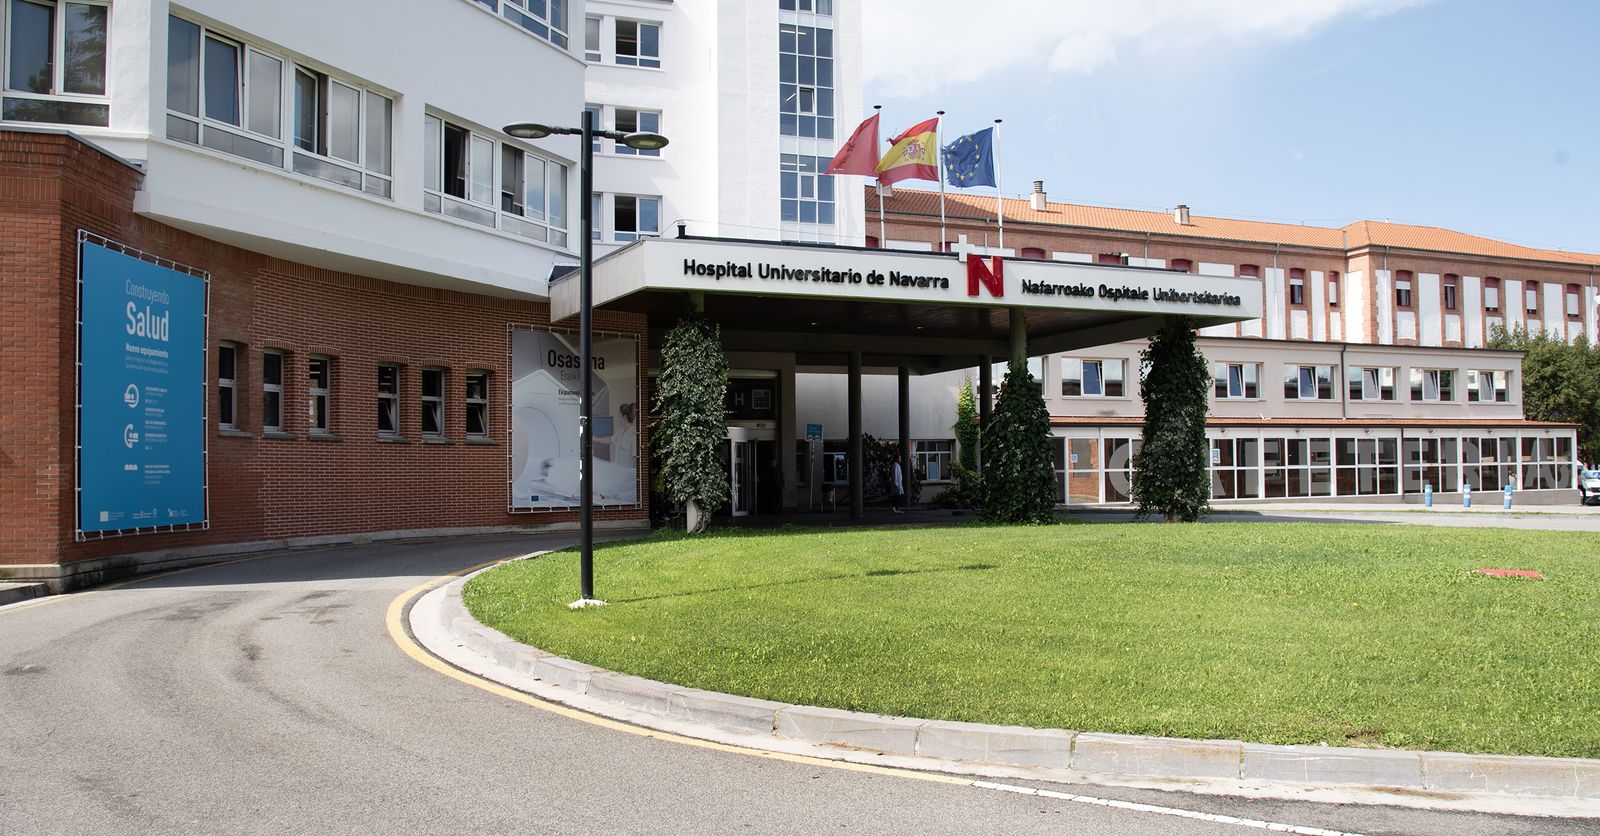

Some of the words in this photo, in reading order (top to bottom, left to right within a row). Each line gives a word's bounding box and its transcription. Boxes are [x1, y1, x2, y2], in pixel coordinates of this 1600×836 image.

[683, 258, 752, 280] Hospital
[758, 263, 862, 284] Universitario
[866, 270, 885, 285] de
[889, 271, 950, 289] Navarra
[967, 254, 1004, 297] N
[126, 279, 170, 304] Construyendo
[1021, 279, 1094, 297] Nafarroako
[1098, 283, 1149, 302] Ospitale
[126, 301, 169, 342] Salud
[547, 349, 605, 370] Osasna
[1108, 439, 1559, 499] CFETERIA
